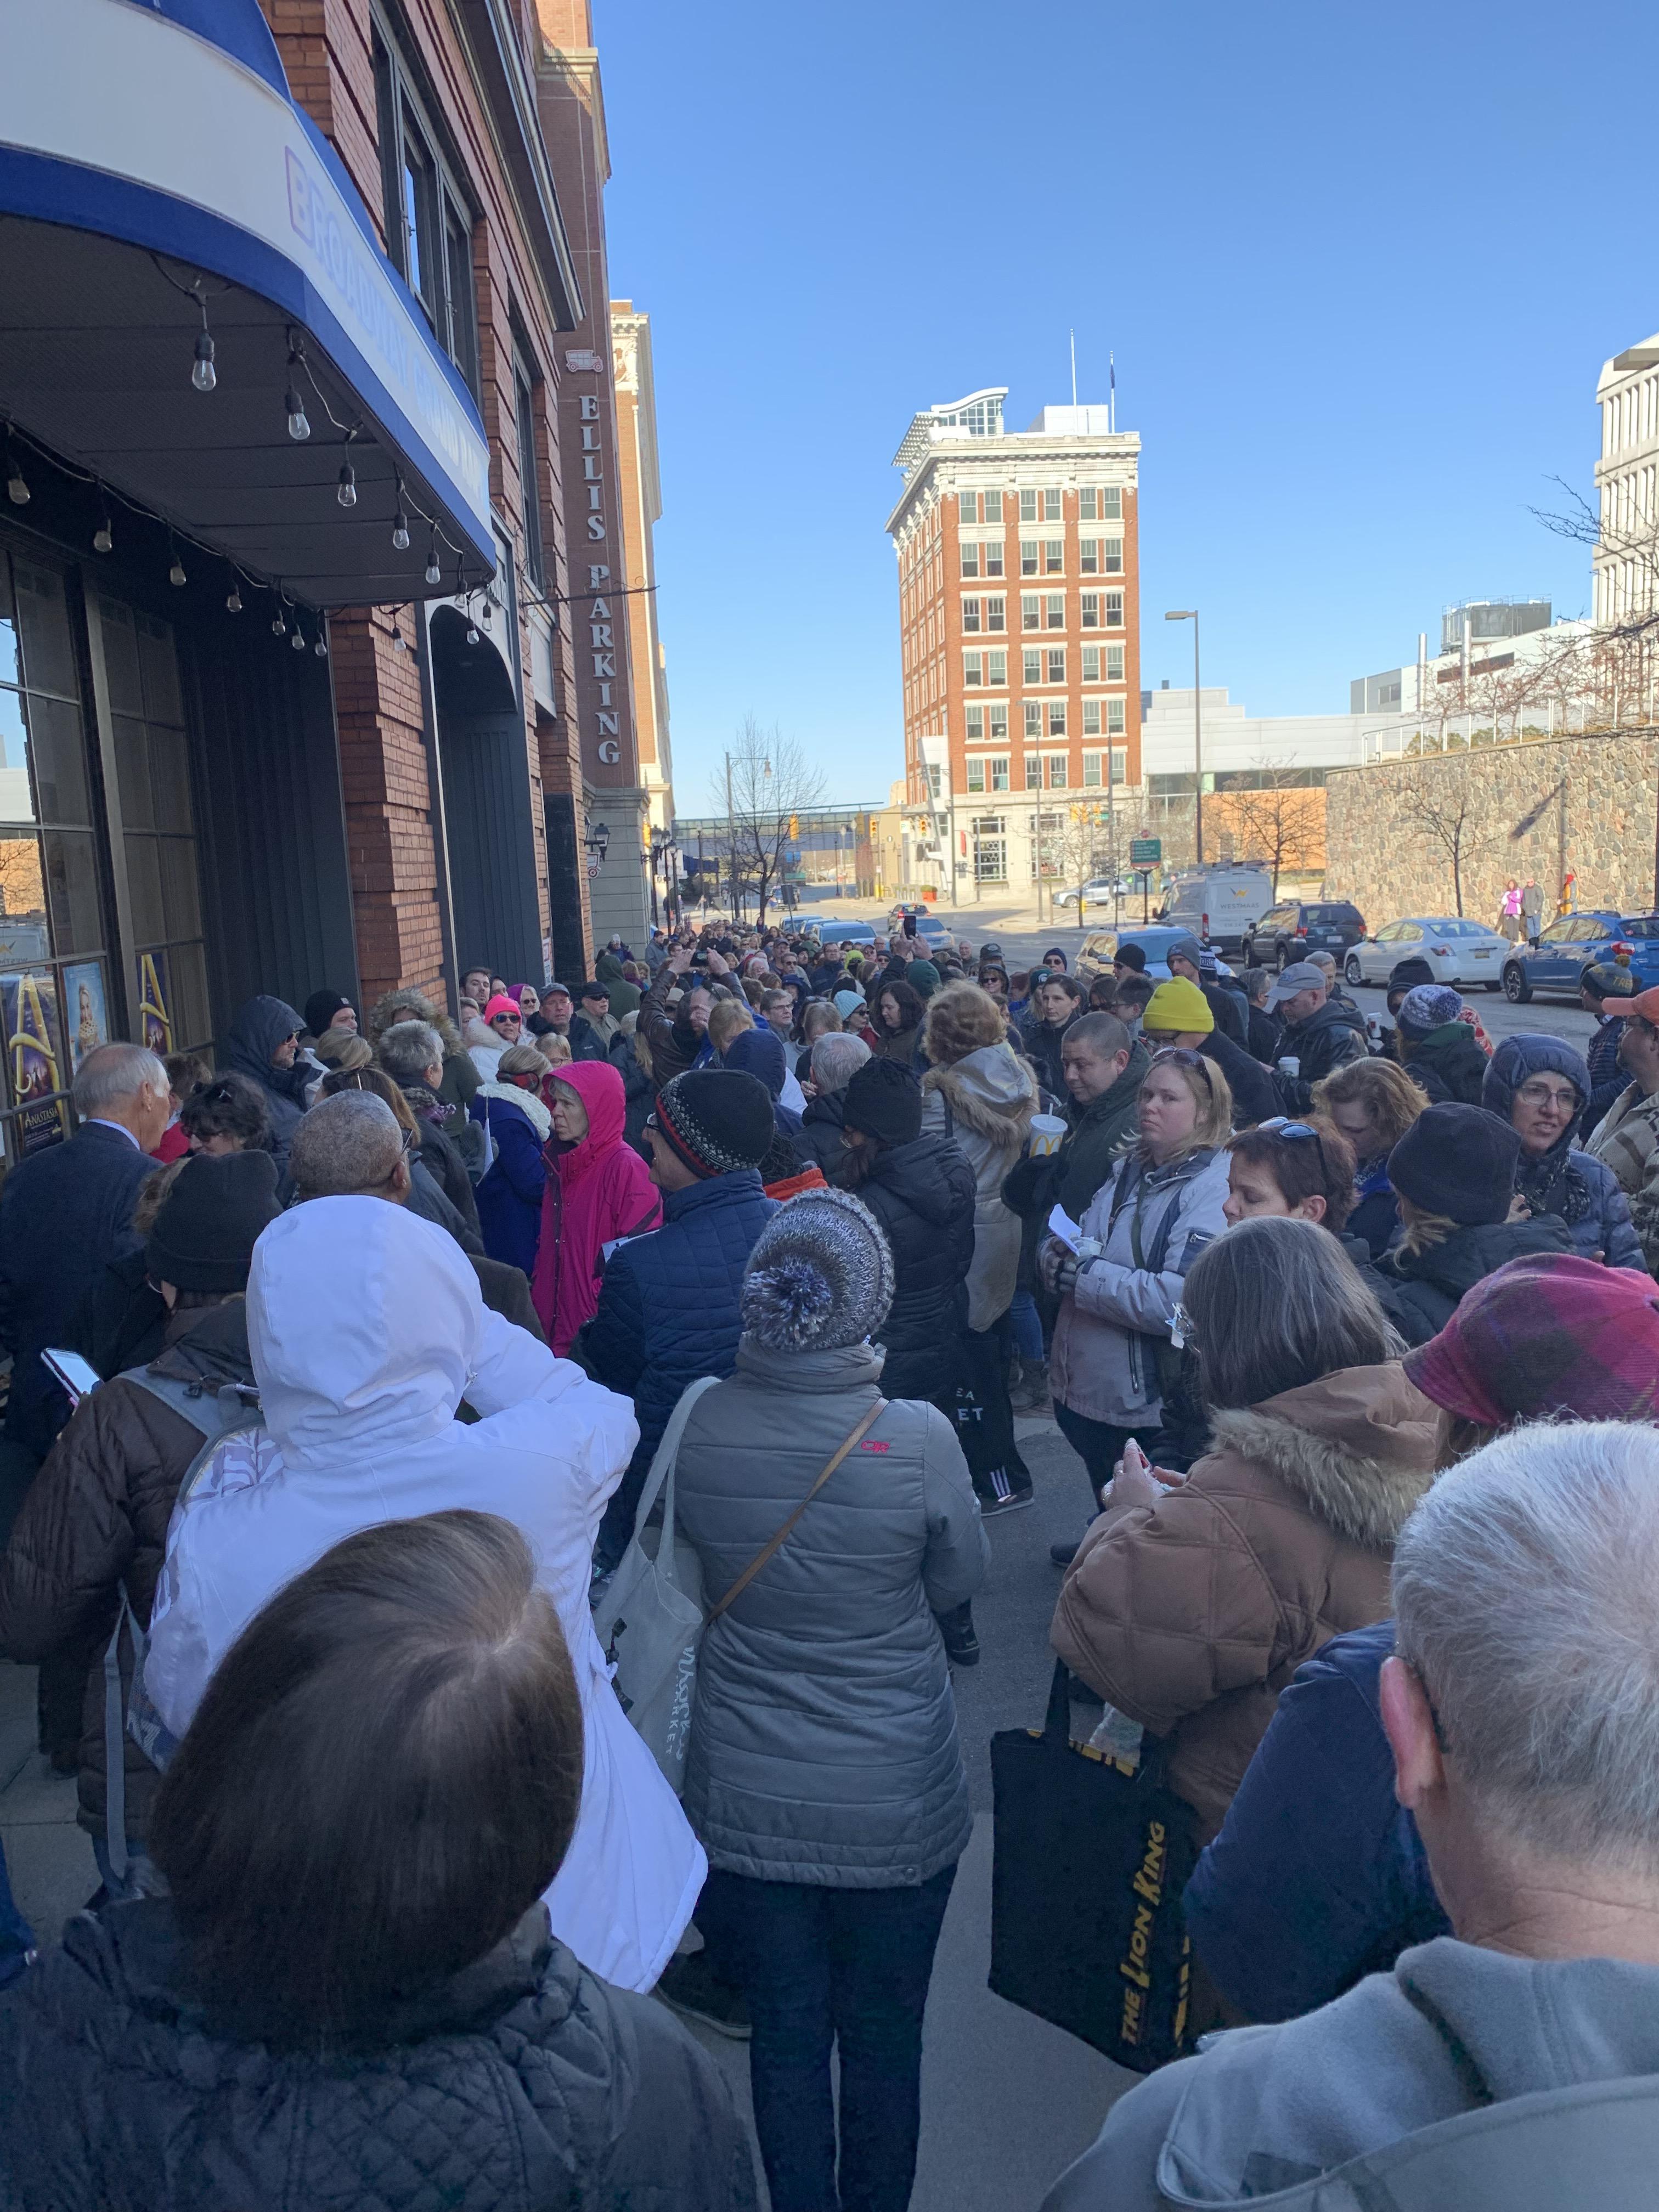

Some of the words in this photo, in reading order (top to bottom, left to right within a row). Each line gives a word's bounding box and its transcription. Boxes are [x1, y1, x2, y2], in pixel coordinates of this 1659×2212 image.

[285, 145, 408, 388] BROADWAY
[579, 395, 606, 541] ELLIS
[588, 565, 622, 764] PARKING
[25, 1107, 58, 1128] ANASTASIA
[958, 1407, 983, 1421] ET
[1133, 1820, 1166, 1905] KING
[1120, 1905, 1152, 1989] LION
[1121, 1987, 1142, 2045] THE
